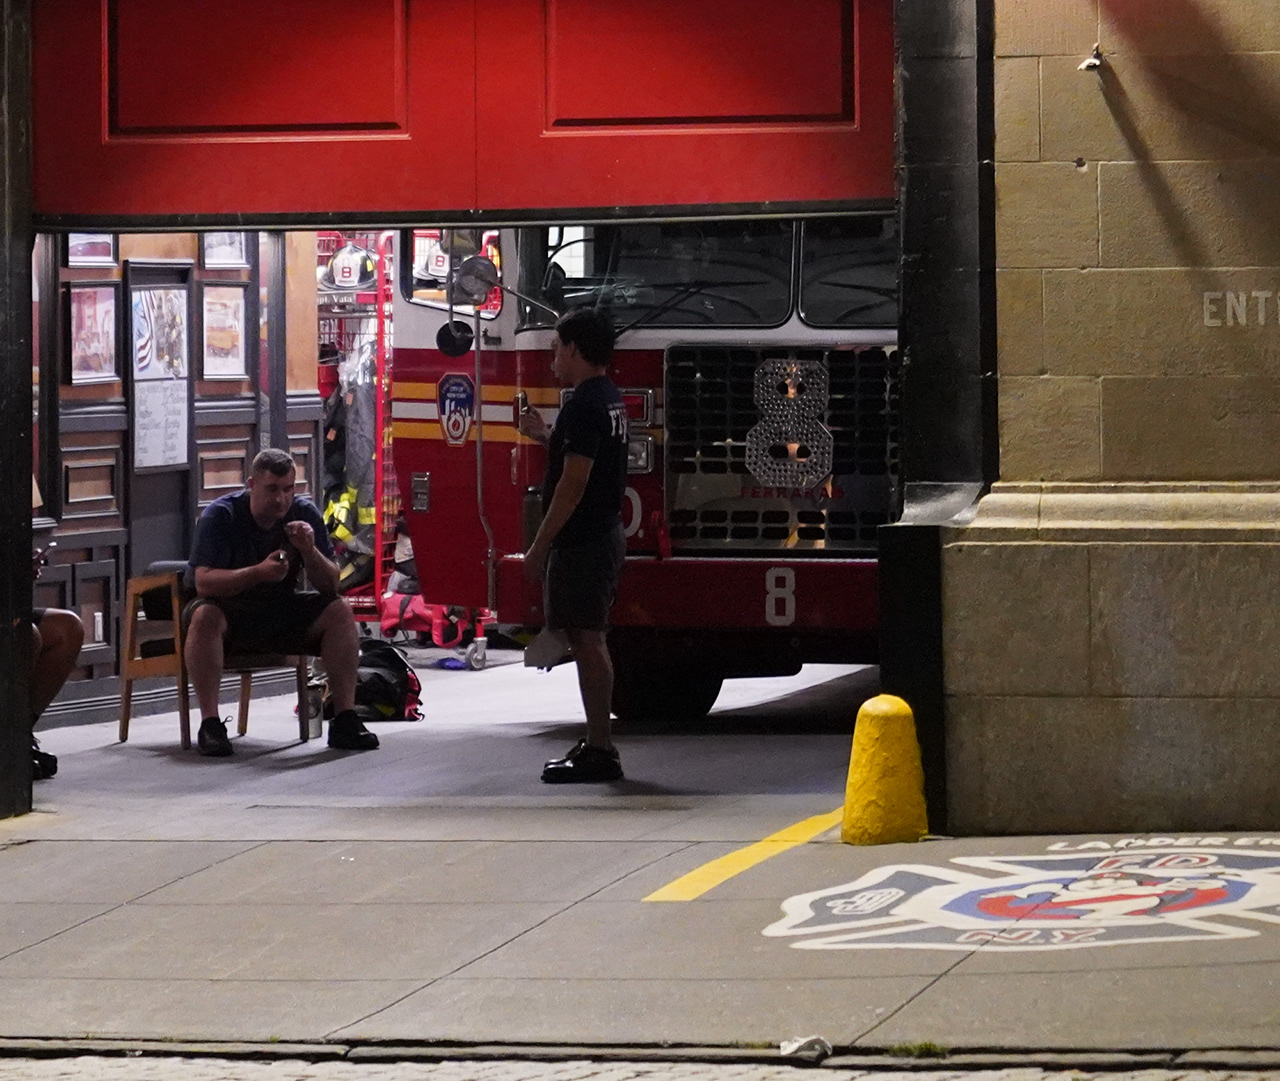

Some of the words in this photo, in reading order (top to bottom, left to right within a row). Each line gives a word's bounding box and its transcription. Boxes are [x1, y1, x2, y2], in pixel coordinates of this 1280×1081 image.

[435, 255, 445, 268] 8
[341, 266, 352, 279] 8
[745, 358, 834, 488] 8
[765, 566, 796, 627] 8
[1047, 836, 1228, 851] LADDER
